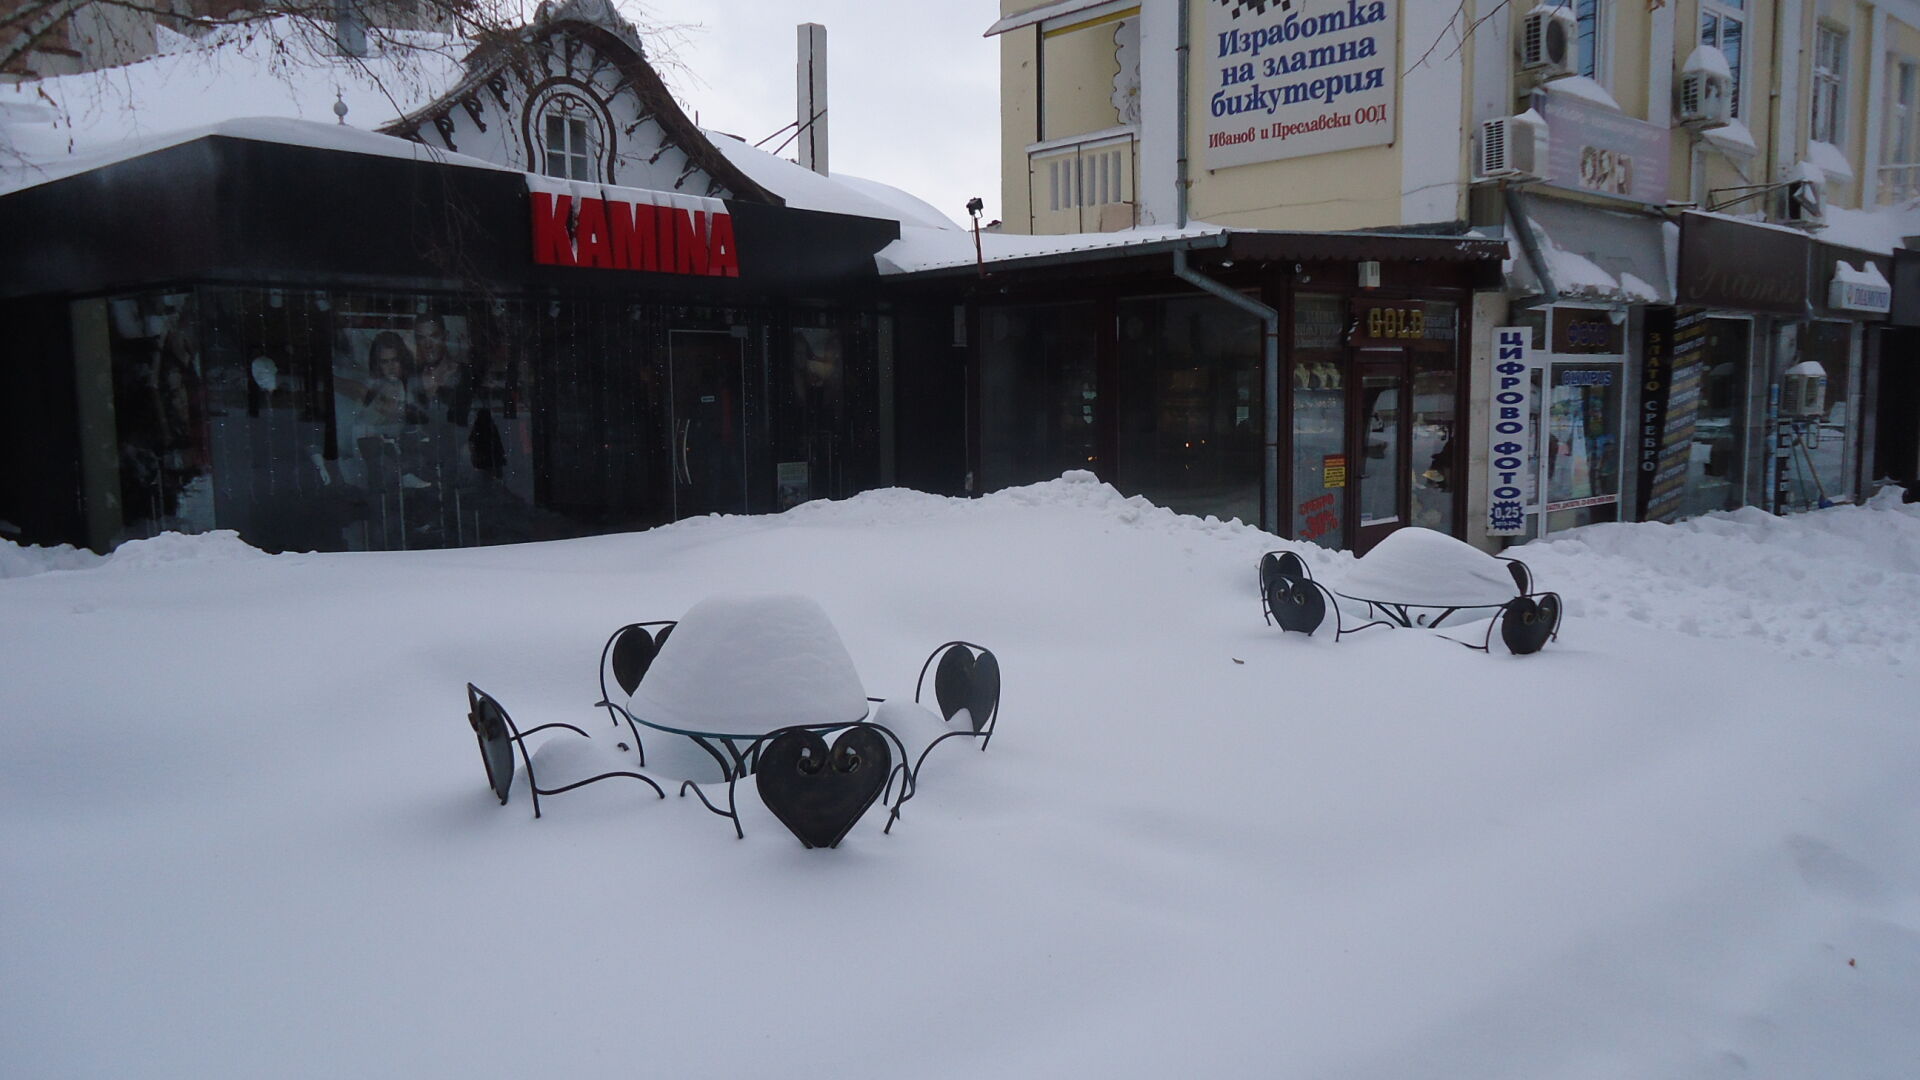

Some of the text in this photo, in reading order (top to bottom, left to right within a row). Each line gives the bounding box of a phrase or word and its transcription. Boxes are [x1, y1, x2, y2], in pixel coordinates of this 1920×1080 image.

[1218, 0, 1386, 58] Изработка
[1221, 36, 1377, 87] на златна
[1211, 66, 1386, 117] бижутерия
[1209, 104, 1387, 148] Иванов и Преславски ООД
[532, 192, 740, 278] KAMINA
[1367, 307, 1425, 340] GOLD
[1568, 320, 1607, 347] ФОТО
[1496, 332, 1526, 435] ЦИФРОВО
[1642, 332, 1661, 472] ЗЛАТО СРЕБРО
[1493, 441, 1523, 500] ФОТО
[1494, 506, 1520, 520] 0,25
